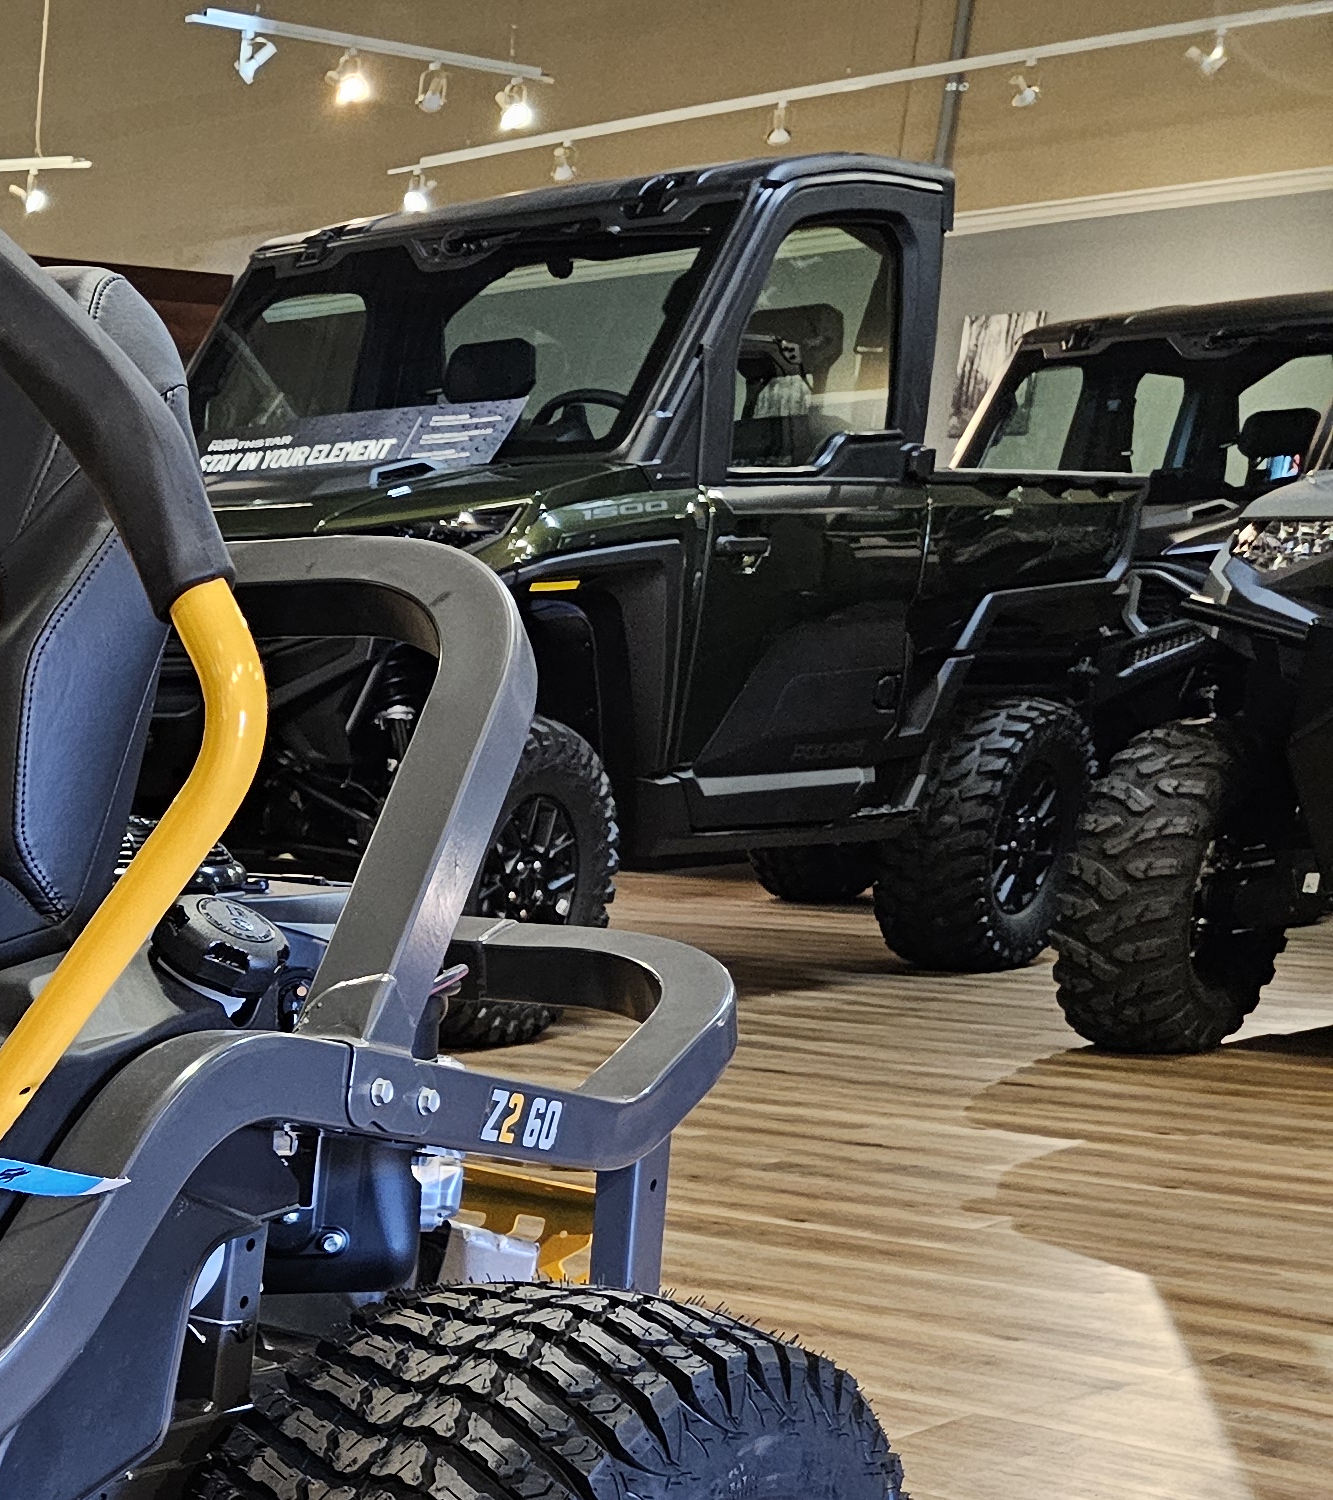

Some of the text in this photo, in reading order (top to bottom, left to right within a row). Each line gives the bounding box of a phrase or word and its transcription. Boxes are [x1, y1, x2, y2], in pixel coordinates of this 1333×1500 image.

[200, 438, 398, 473] STAY IN YOUR ELEMENT
